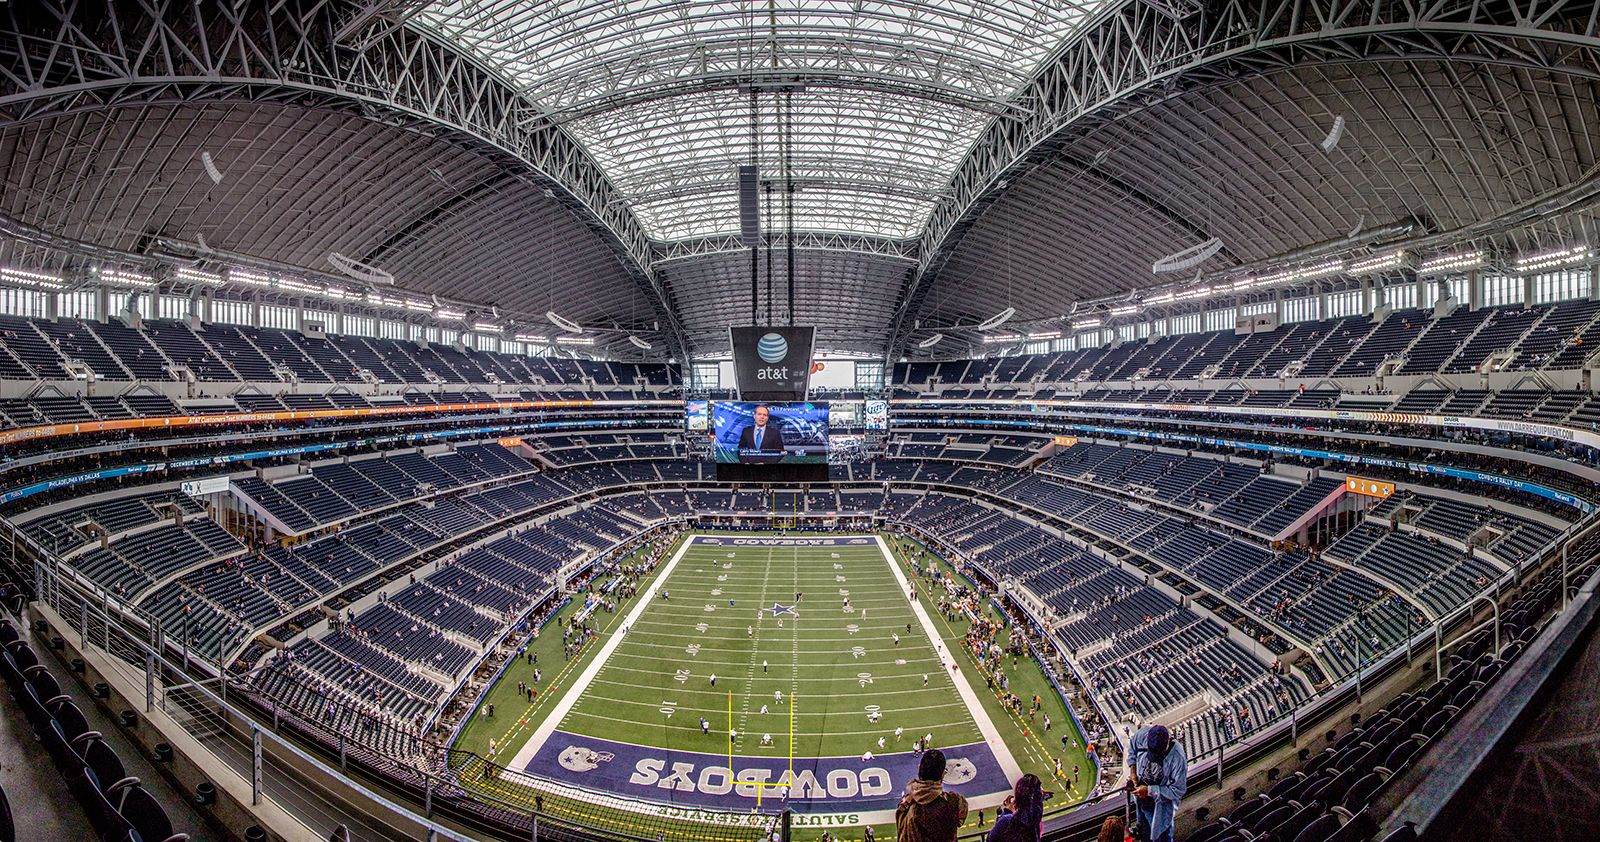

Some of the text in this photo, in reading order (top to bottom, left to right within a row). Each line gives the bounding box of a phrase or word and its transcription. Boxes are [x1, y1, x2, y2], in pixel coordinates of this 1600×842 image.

[757, 366, 788, 380] at&t
[1497, 421, 1574, 440] WWW.DARREQUIPMENT.COM
[170, 460, 194, 468] DECEMBER
[1362, 457, 1386, 465] DECEMBER
[48, 477, 77, 488] PHILADELPHIA
[84, 472, 100, 480] DALLAS
[1478, 473, 1498, 483] COWBOYS
[1499, 477, 1513, 486] RALLY
[659, 700, 677, 714] 10
[629, 759, 893, 798] COWBOYS
